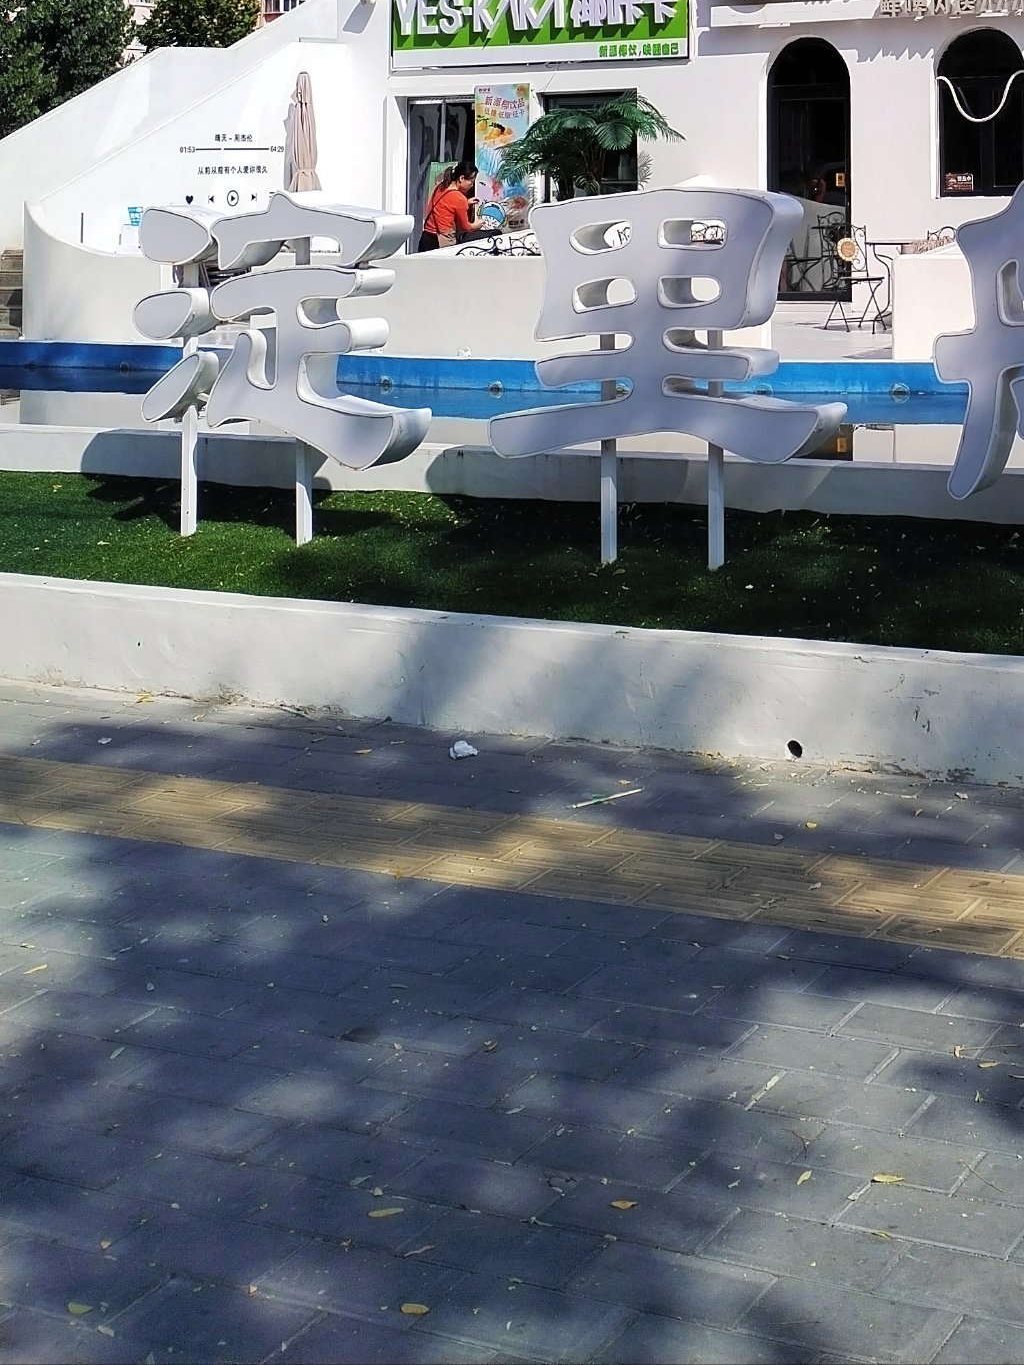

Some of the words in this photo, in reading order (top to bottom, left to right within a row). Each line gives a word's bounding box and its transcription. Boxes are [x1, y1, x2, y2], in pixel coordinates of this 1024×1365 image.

[197, 165, 268, 175] 从前从前有个人爱你很久
